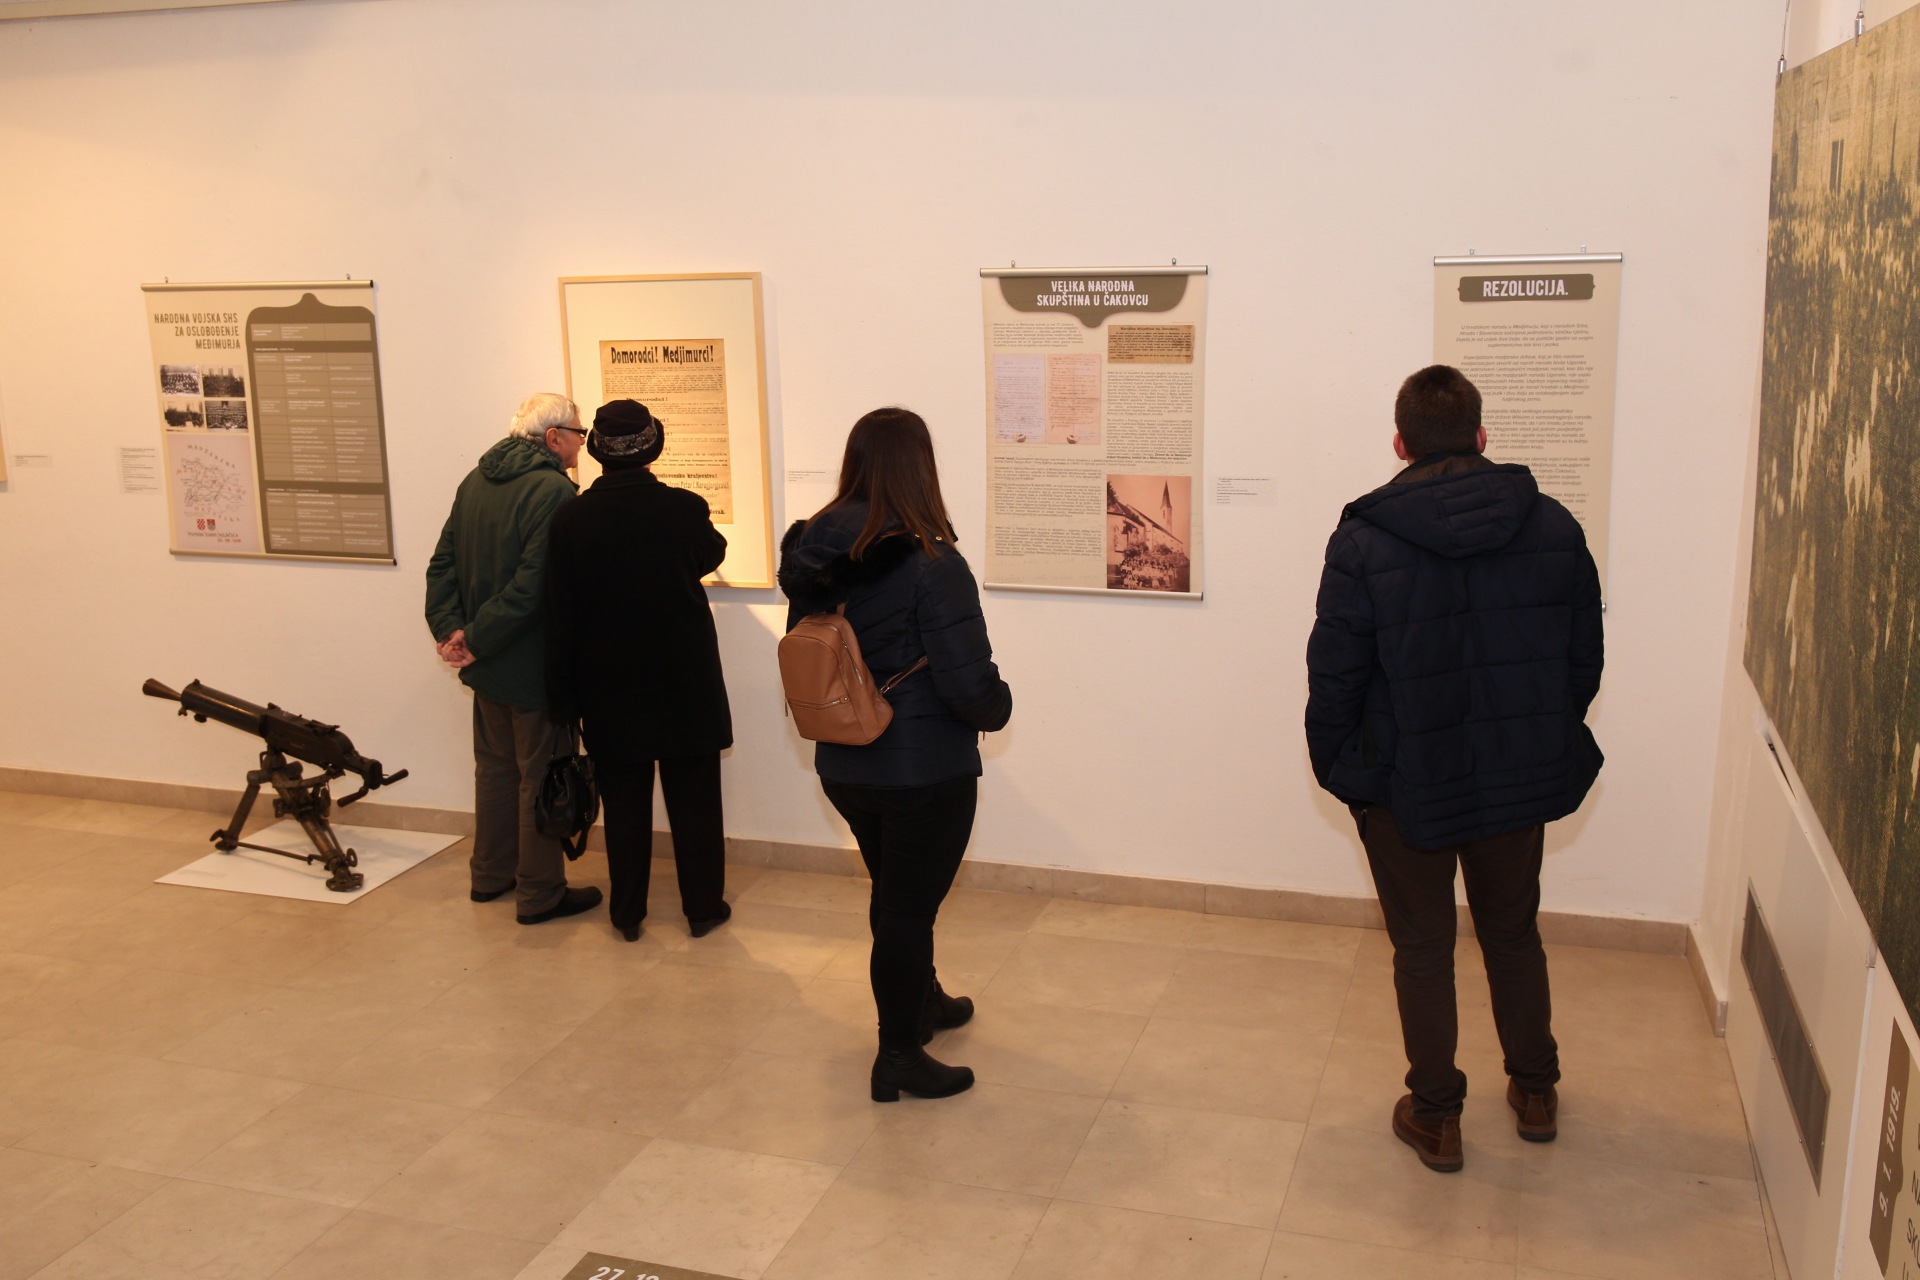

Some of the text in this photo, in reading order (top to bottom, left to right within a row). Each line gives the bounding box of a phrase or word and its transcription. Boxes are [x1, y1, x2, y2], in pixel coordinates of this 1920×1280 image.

[1051, 280, 1134, 292] VELIKA NARODNA
[1482, 278, 1568, 296] REZOLUCIJA.
[1036, 291, 1148, 306] SKUPŠTINA U ČAKOVCU
[154, 312, 238, 323] NARODNA VOJSKA SHS
[174, 326, 240, 336] ZA OSLOBOĐENJE
[195, 338, 241, 349] MEĐIMURJA
[610, 345, 714, 364] Domorodci! Medjimurci!
[1878, 1190, 1888, 1217] 9.
[1886, 1086, 1900, 1152] 1919.
